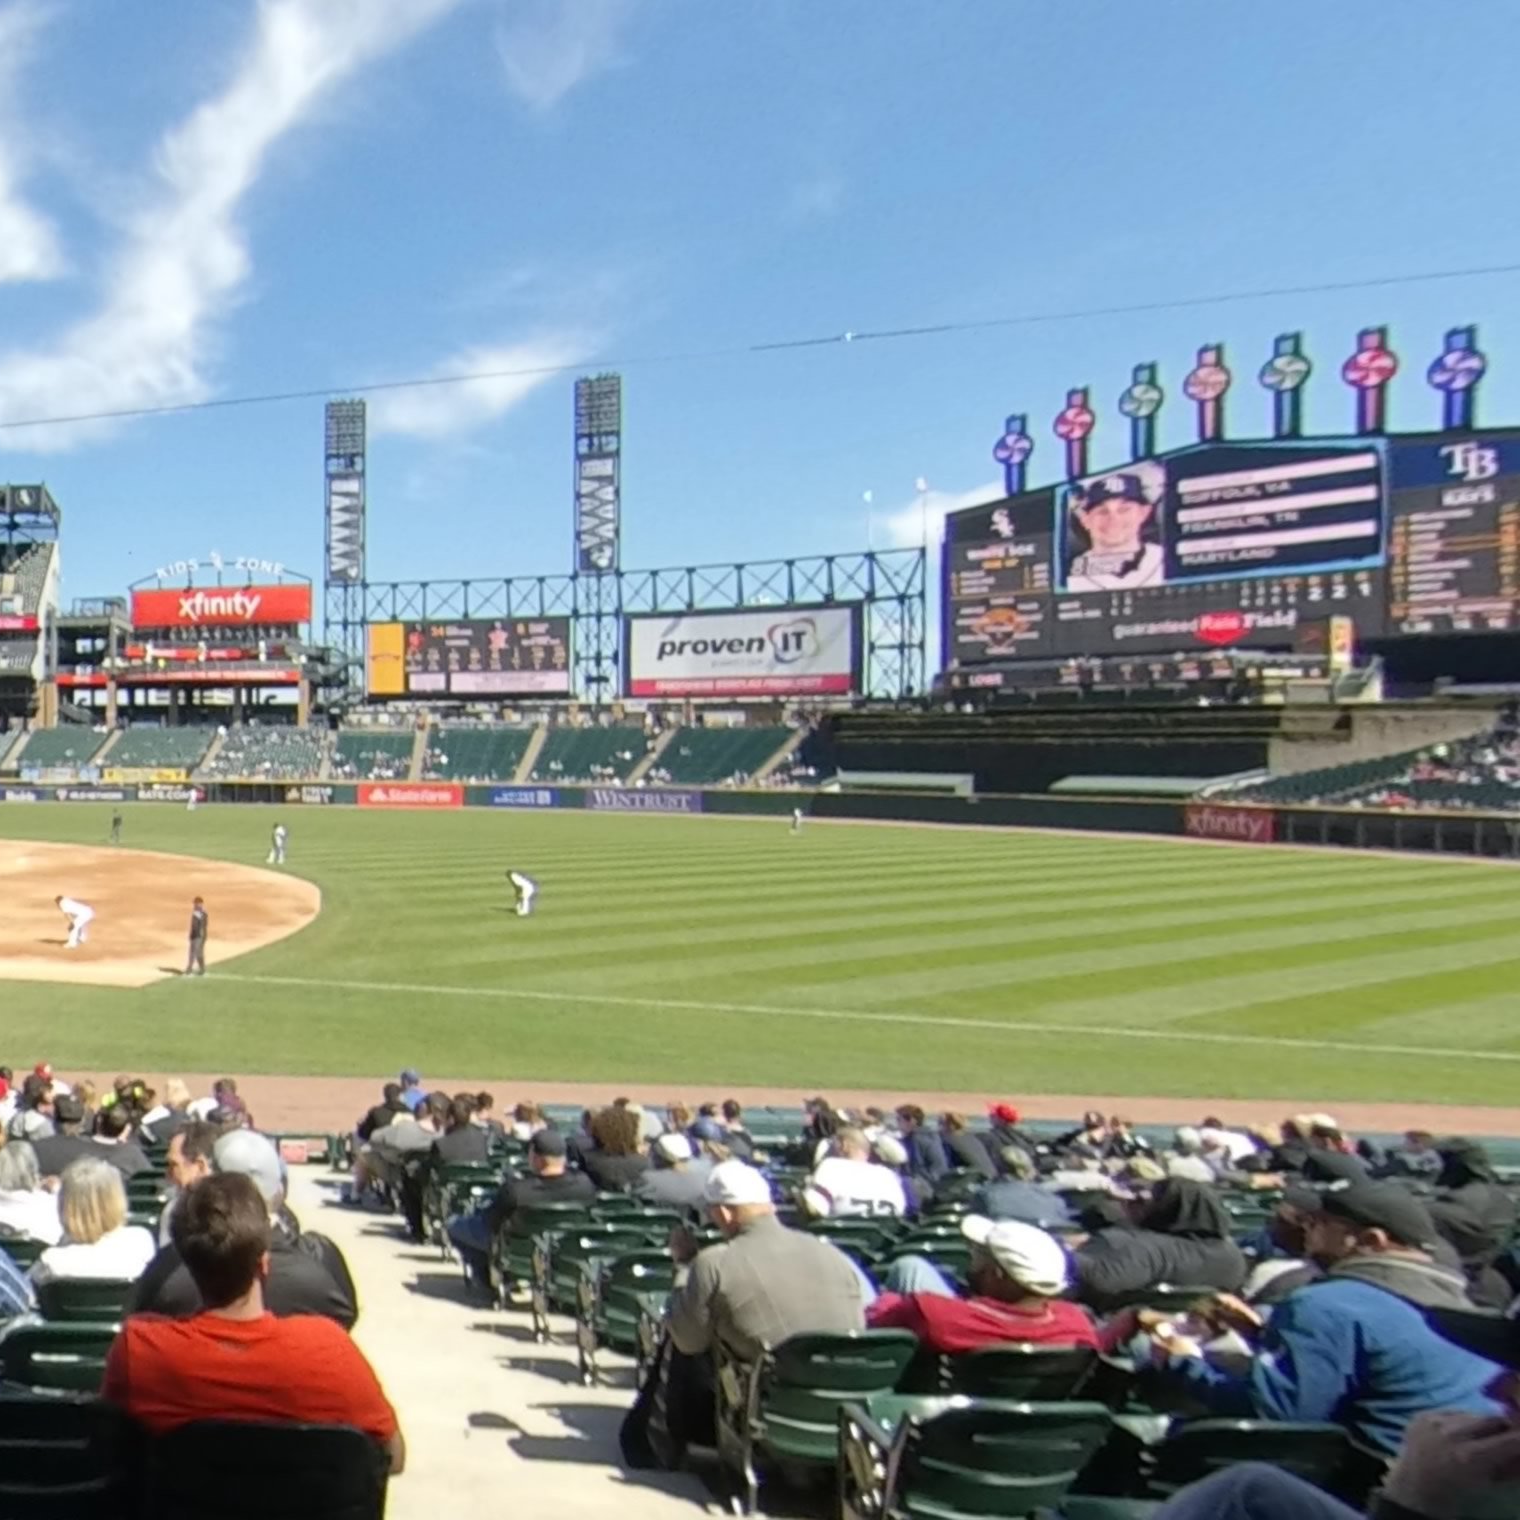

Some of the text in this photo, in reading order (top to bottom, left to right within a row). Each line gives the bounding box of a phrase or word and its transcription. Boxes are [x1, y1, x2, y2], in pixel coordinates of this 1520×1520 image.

[1439, 441, 1498, 481] TB
[156, 556, 286, 579] KIDS ZONE
[179, 592, 261, 621] xfinity
[1113, 619, 1198, 640] guaranteed
[1244, 609, 1297, 628] Field
[657, 631, 808, 661] proven IT
[593, 789, 691, 810] WINTRUST
[1186, 807, 1264, 839] xfinity
